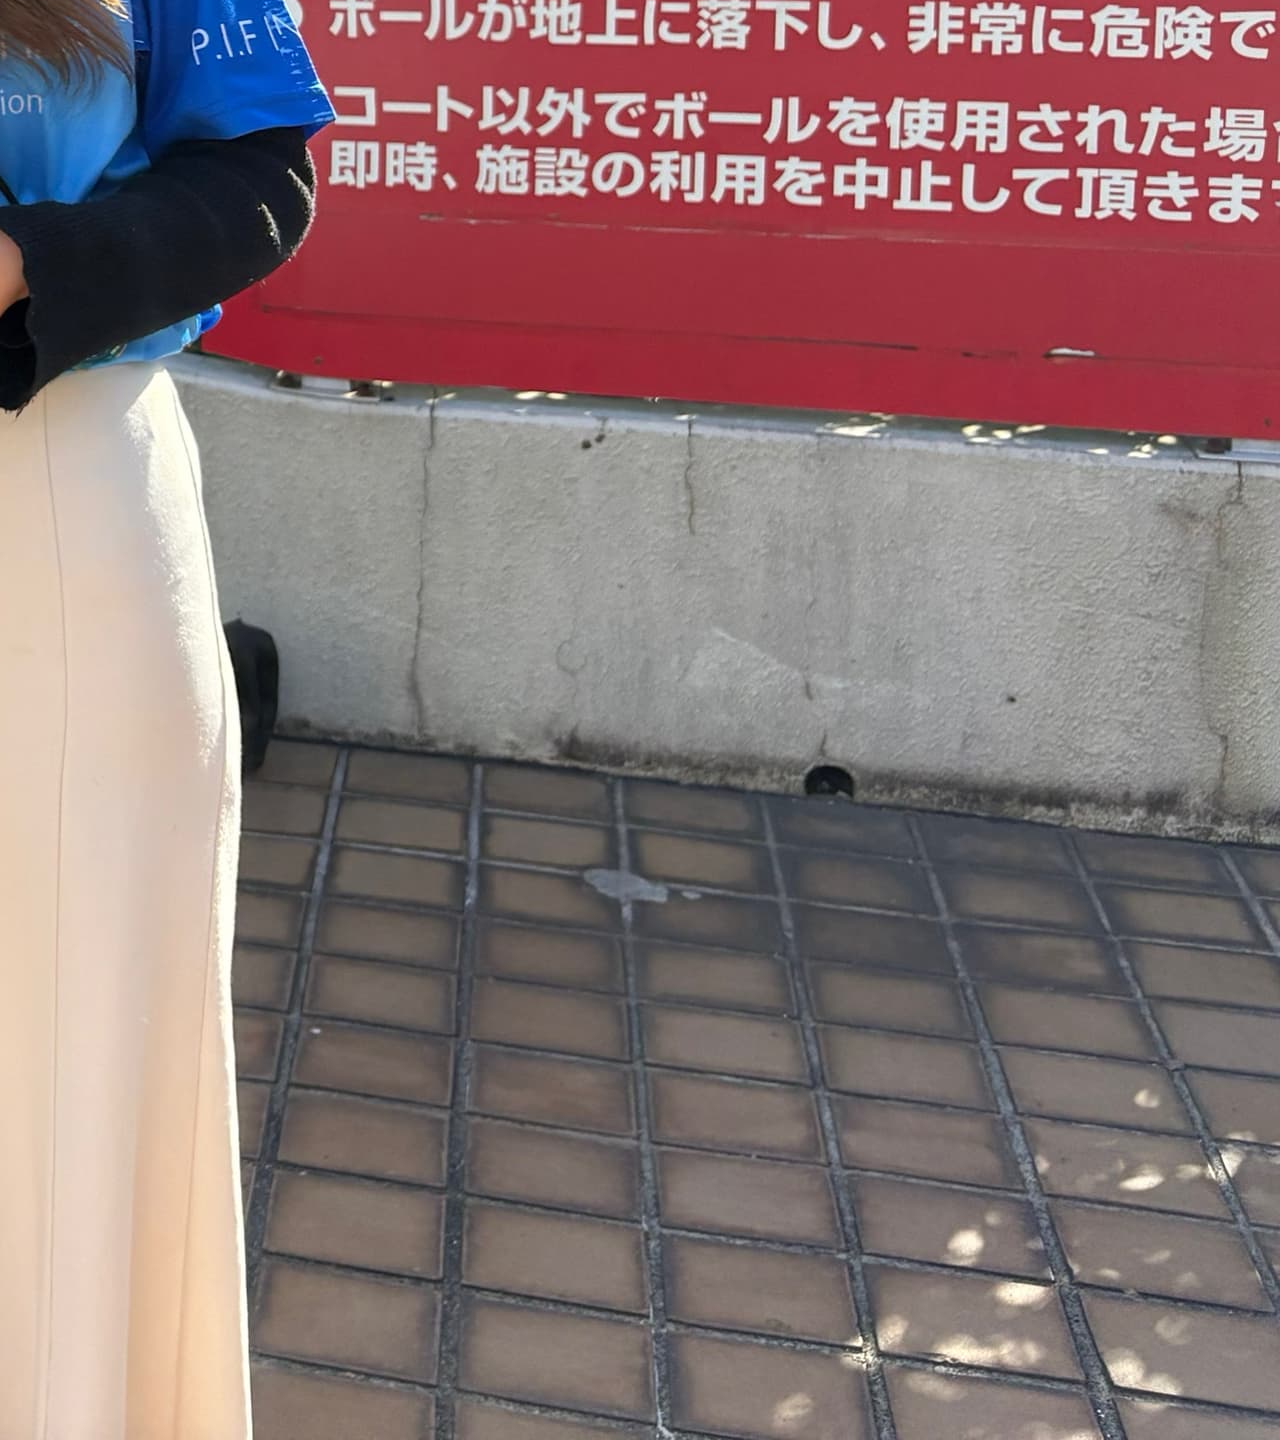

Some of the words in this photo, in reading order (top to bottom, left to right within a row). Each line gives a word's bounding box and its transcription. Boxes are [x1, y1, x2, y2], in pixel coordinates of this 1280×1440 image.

[333, 85, 1280, 162] コート以外でボールを使用された場
